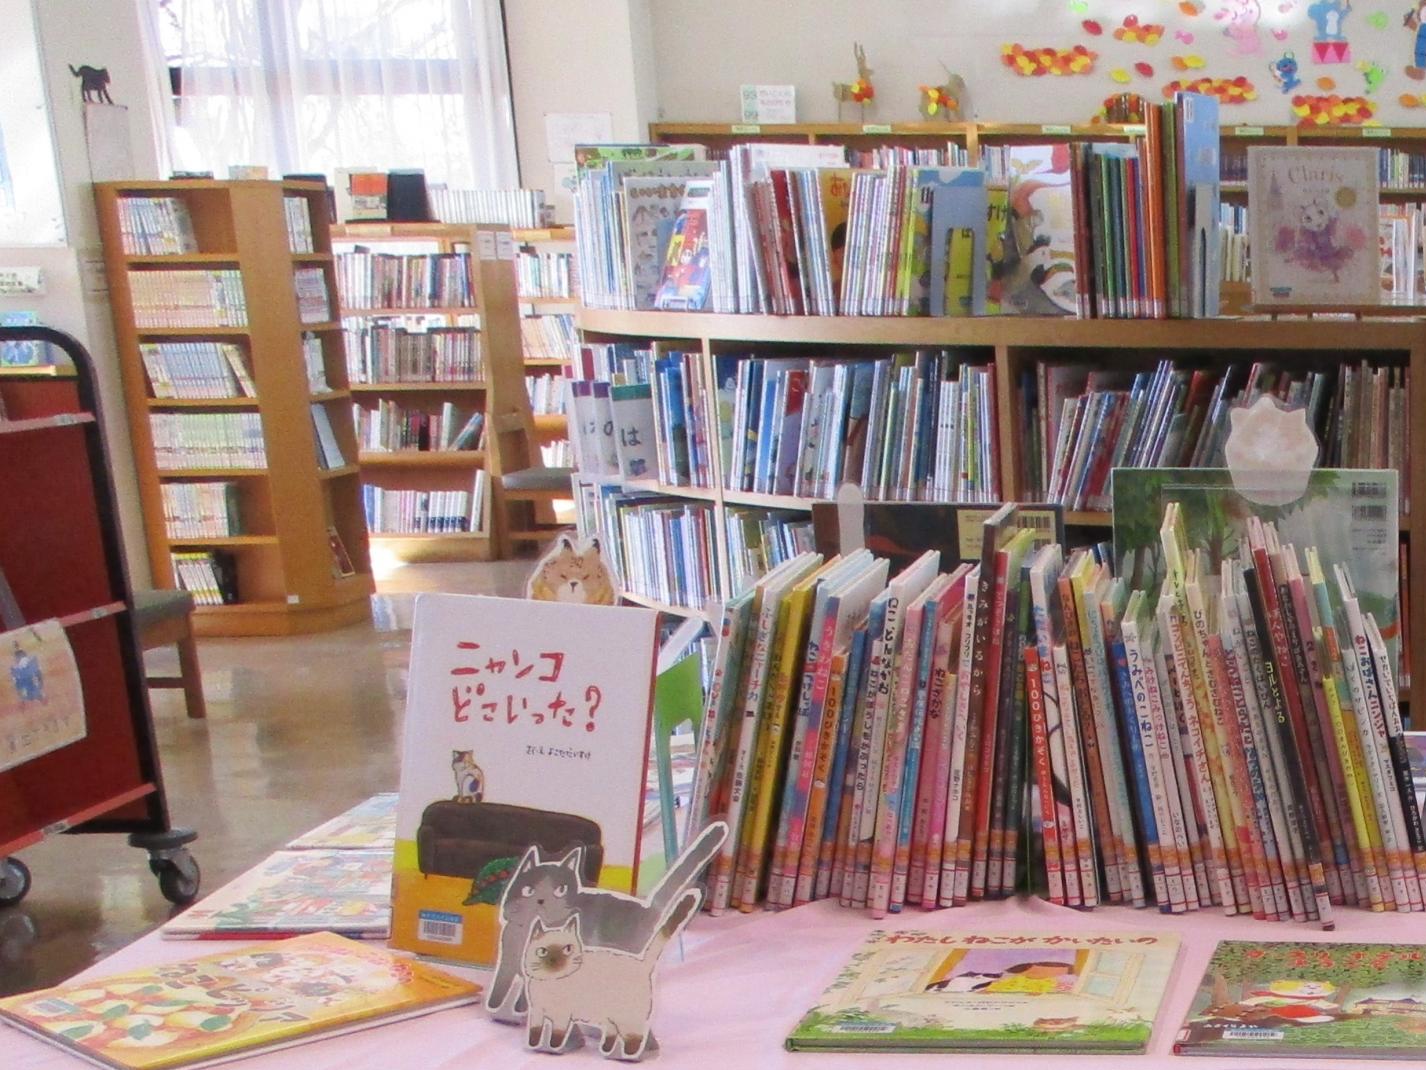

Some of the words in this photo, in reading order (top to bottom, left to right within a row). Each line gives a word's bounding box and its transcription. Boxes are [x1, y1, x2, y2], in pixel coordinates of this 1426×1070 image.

[621, 426, 643, 447] は
[451, 640, 565, 683] ニャンコ
[452, 682, 602, 732] どこいった？
[1129, 649, 1154, 748] うみべのこねこ
